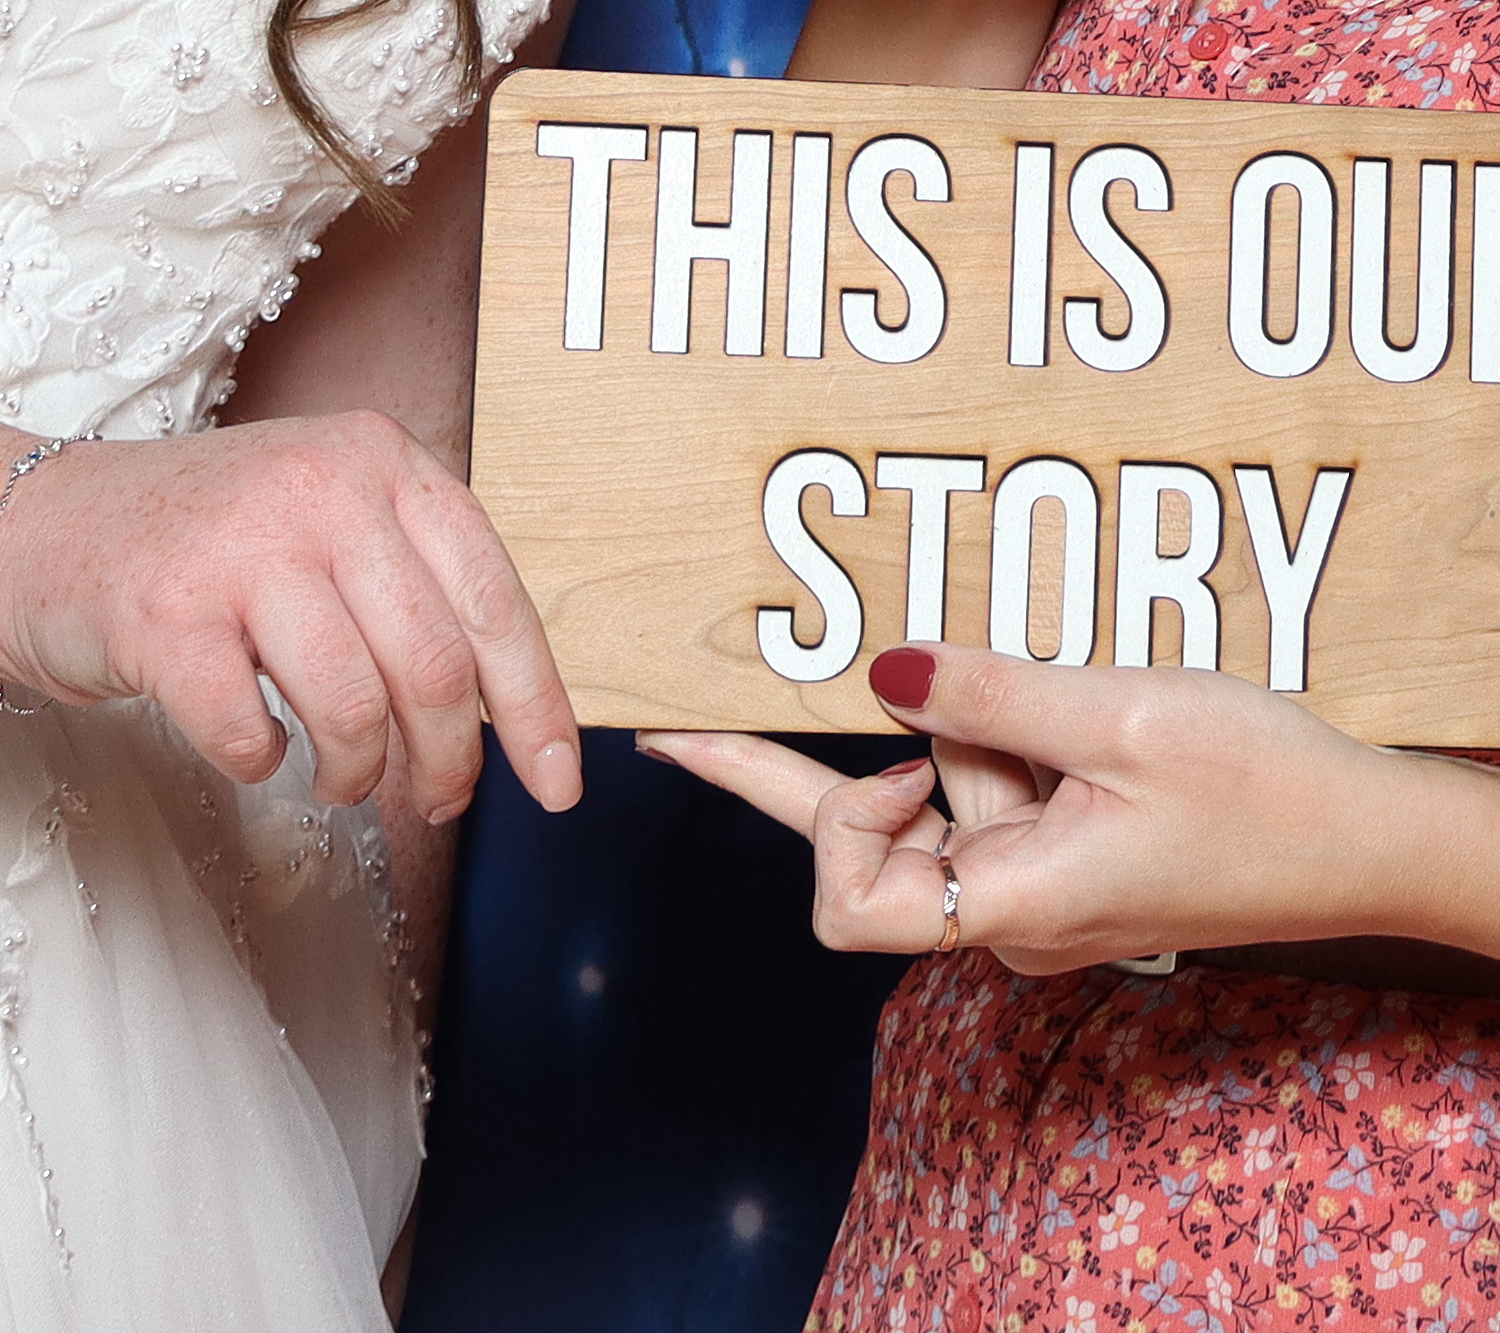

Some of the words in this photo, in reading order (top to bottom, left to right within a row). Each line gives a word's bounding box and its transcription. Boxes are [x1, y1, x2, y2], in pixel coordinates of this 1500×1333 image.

[535, 121, 953, 364] THIS
[1007, 141, 1173, 373] IS
[755, 447, 1354, 693] STORY
